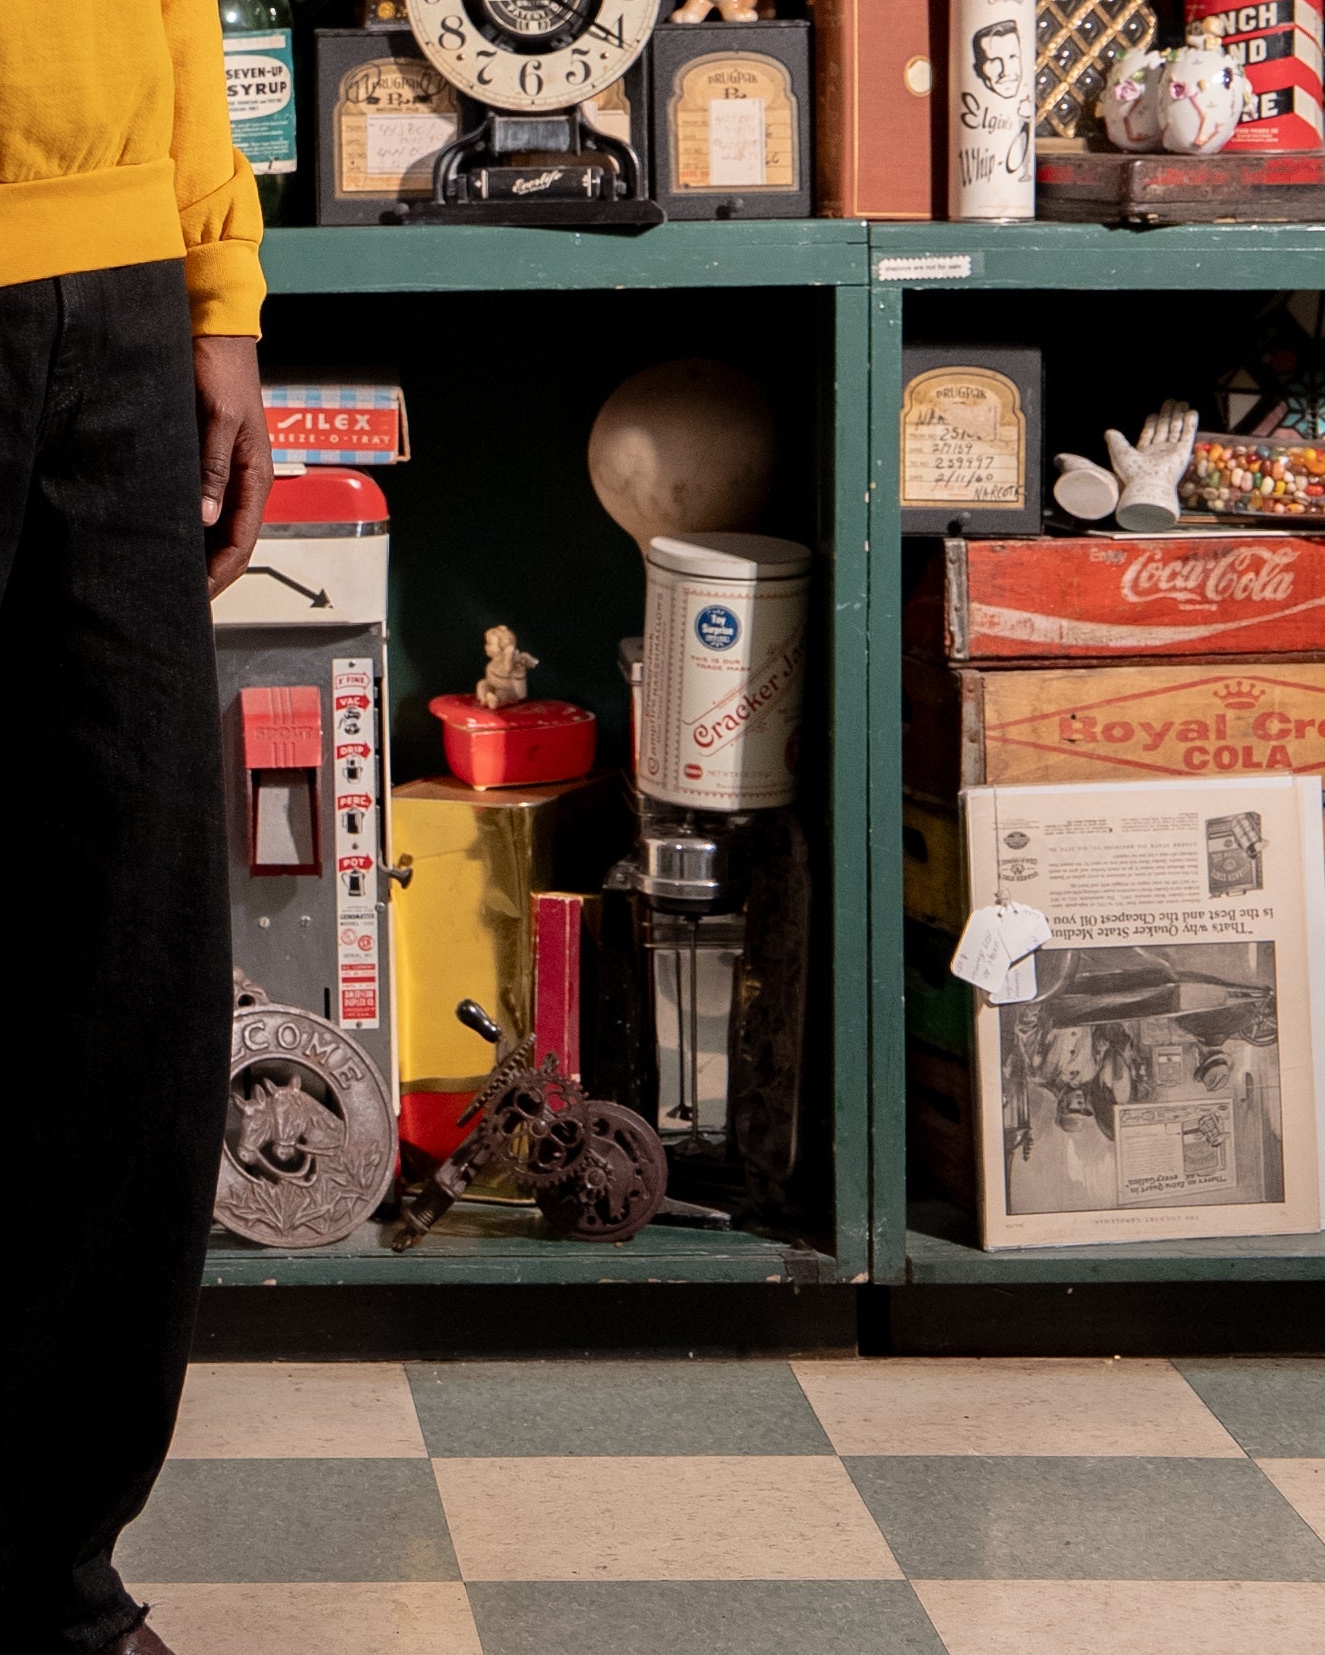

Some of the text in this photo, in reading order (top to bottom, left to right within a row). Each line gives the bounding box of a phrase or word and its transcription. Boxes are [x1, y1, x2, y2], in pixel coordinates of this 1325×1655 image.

[438, 15, 467, 52] 8
[226, 64, 284, 80] SEVEN-UP
[475, 49, 498, 86] 7
[565, 47, 592, 86] 5
[518, 59, 544, 97] 6
[226, 81, 288, 98] SYRUP
[277, 413, 372, 431] SILEX
[1121, 545, 1301, 604] Coca-Cola
[346, 675, 365, 685] FINE
[339, 697, 364, 706] VAC.
[692, 673, 779, 749] Cracker
[1058, 710, 1325, 752] Royal Cro
[340, 746, 364, 756] DRIP
[1183, 745, 1294, 771] COLA
[339, 796, 369, 807] PERC.
[342, 856, 365, 867] POT
[1053, 908, 1274, 927] is the Best and the Cheapest Oil you
[1050, 928, 1094, 940] Mediu
[1097, 927, 1130, 939] State
[1133, 922, 1178, 938] Quaker
[1182, 922, 1208, 936] why
[230, 1021, 365, 1092] LCOME
